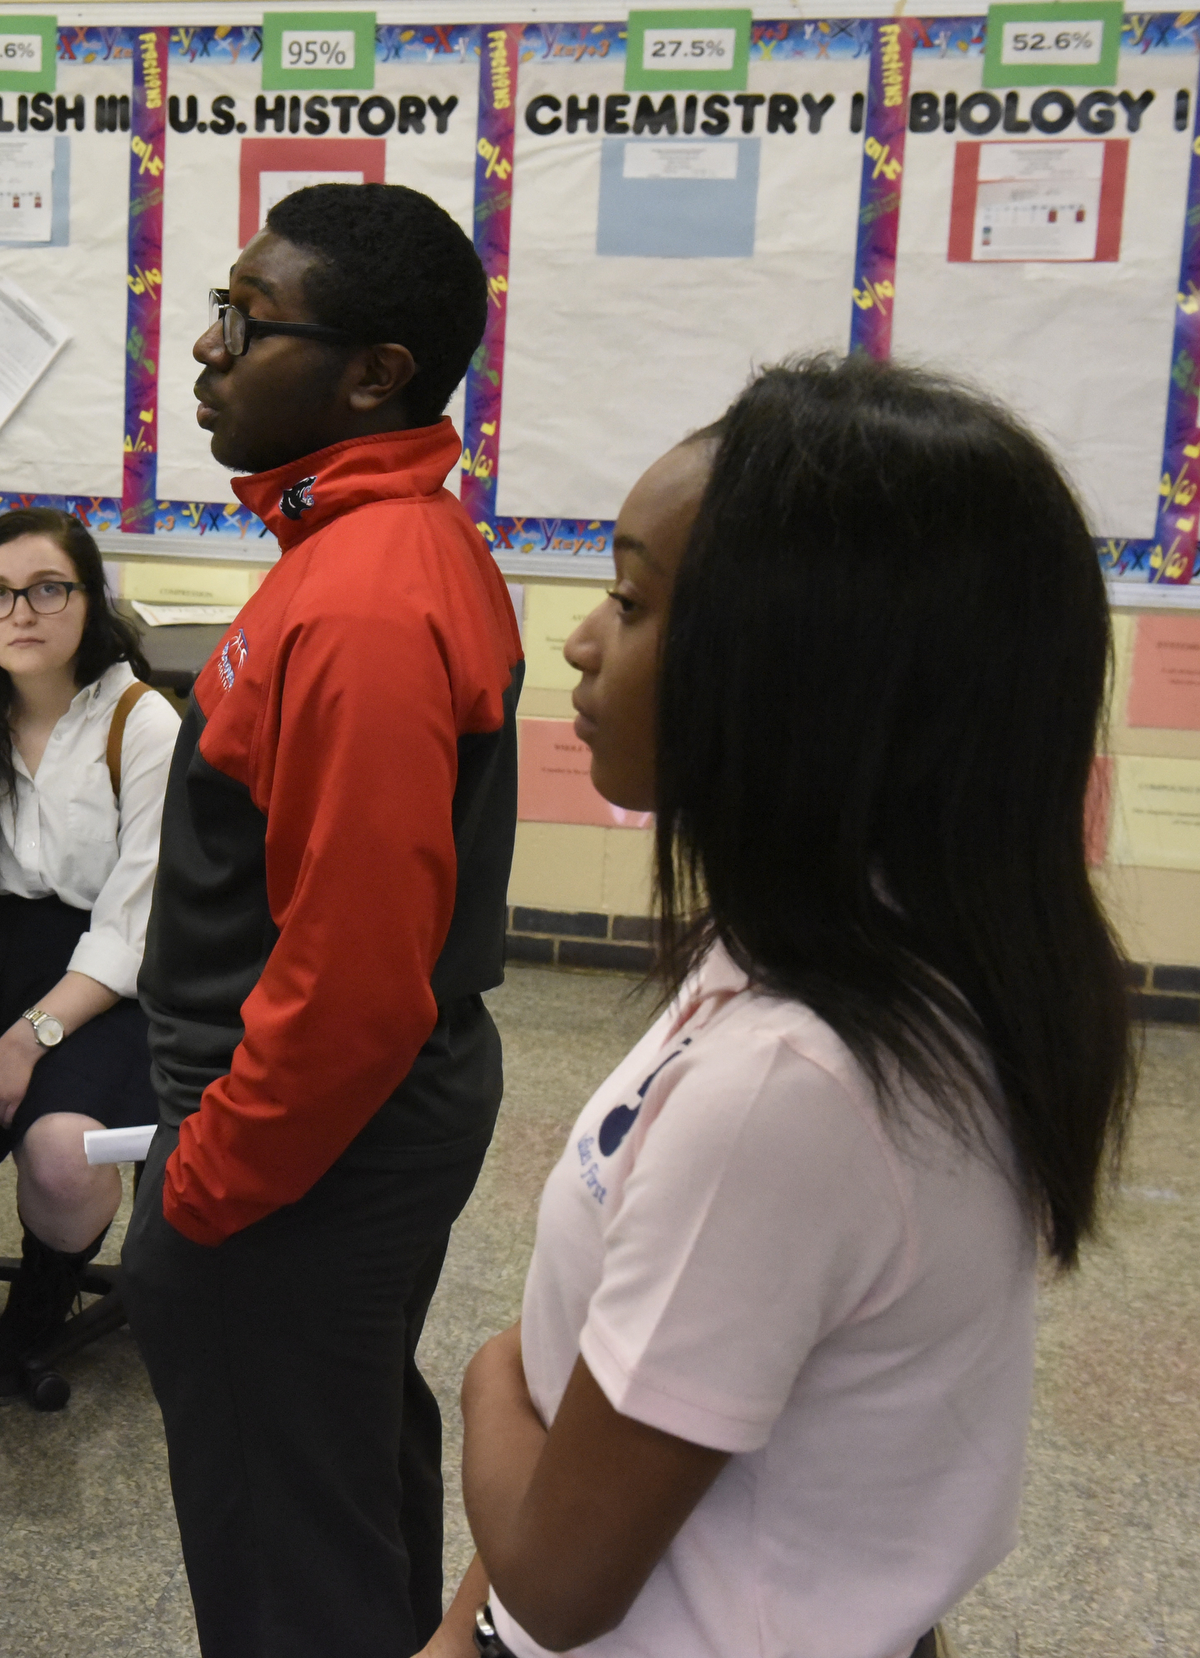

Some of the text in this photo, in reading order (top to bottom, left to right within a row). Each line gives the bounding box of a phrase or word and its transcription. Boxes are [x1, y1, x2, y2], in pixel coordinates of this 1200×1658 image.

[288, 40, 346, 66] 95%
[652, 40, 726, 58] 27.5%
[1013, 31, 1093, 52] 52.6%
[95, 94, 131, 132] III
[167, 95, 459, 136] U.S. HISTORY
[525, 92, 865, 136] CHEMISTRY I
[908, 89, 1190, 136] BIOLOGY I
